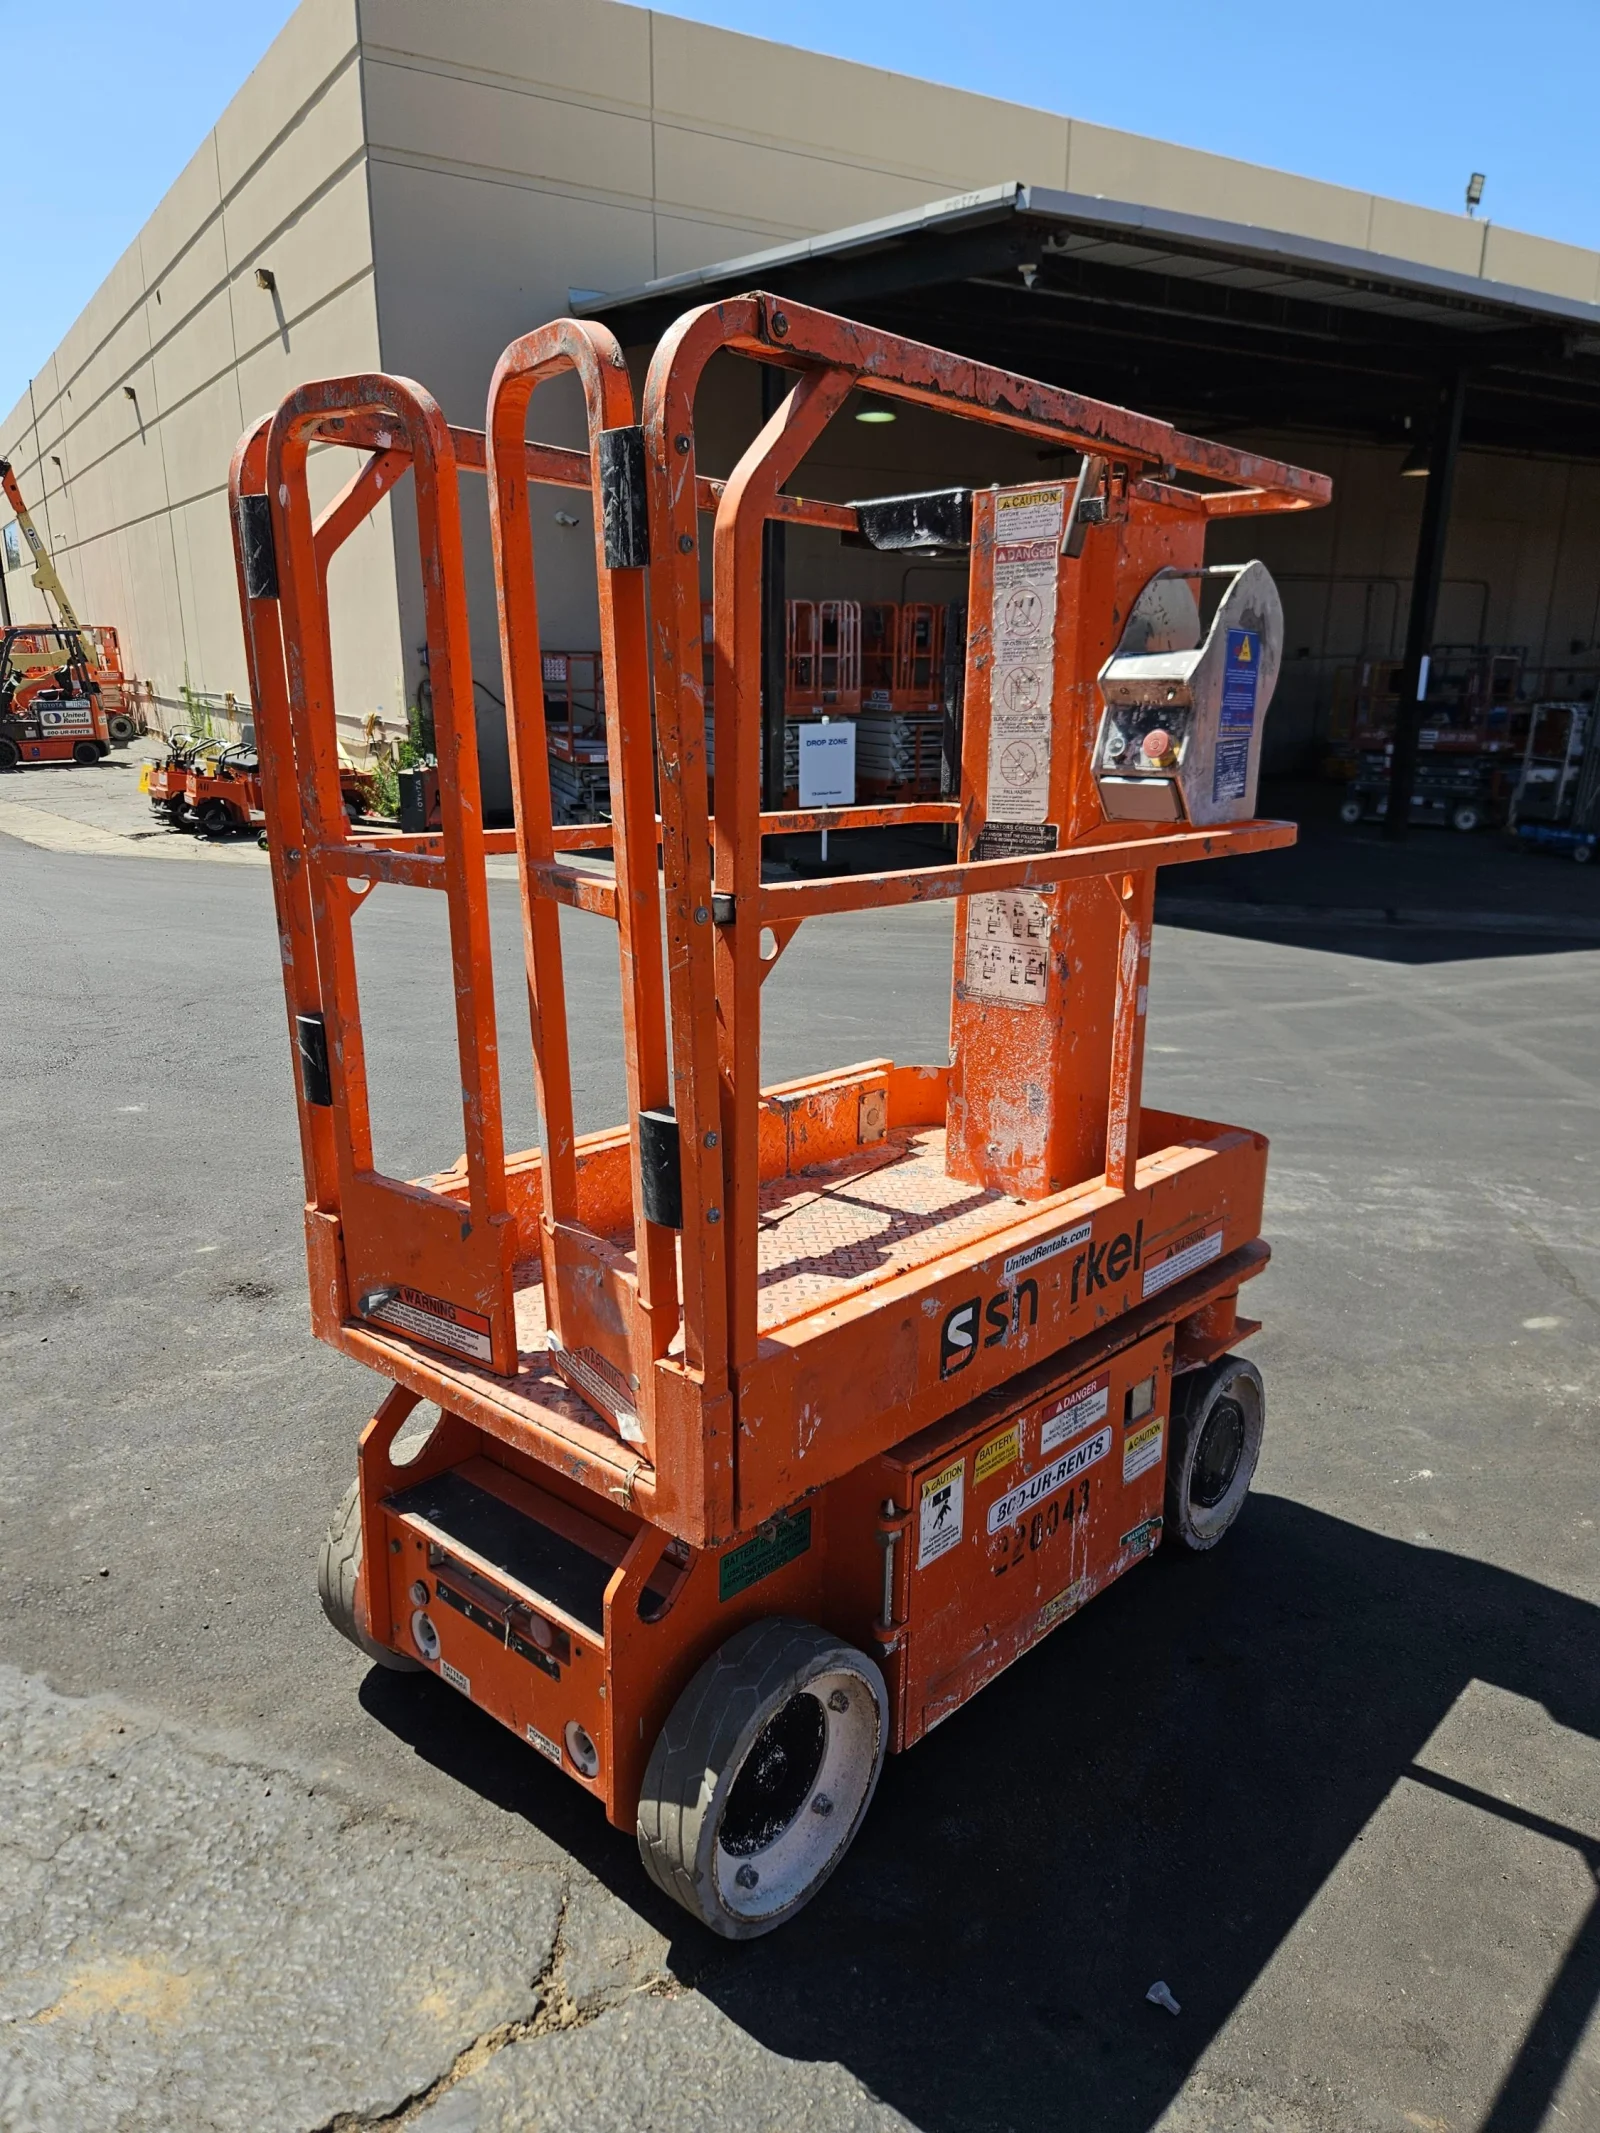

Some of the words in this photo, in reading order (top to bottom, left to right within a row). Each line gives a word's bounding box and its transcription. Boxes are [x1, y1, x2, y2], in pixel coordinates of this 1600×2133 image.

[1012, 493, 1057, 507] CAUTION
[1008, 545, 1054, 560] DANGER
[1005, 1227, 1090, 1272] UnitedRentals.com
[404, 1288, 457, 1320] WARNING
[582, 1348, 620, 1388] WARNING
[1063, 1381, 1096, 1408] DANGER
[980, 1432, 1014, 1462] BATTERY
[1133, 1422, 1161, 1447] CAUTION
[931, 1464, 962, 1490] CAUTION
[724, 1543, 760, 1568] BATTERY
[443, 1663, 466, 1685] BATTERY
[530, 1728, 551, 1748] POWER
[552, 1744, 560, 1754] TO
[530, 1735, 560, 1763] PLTFORM
